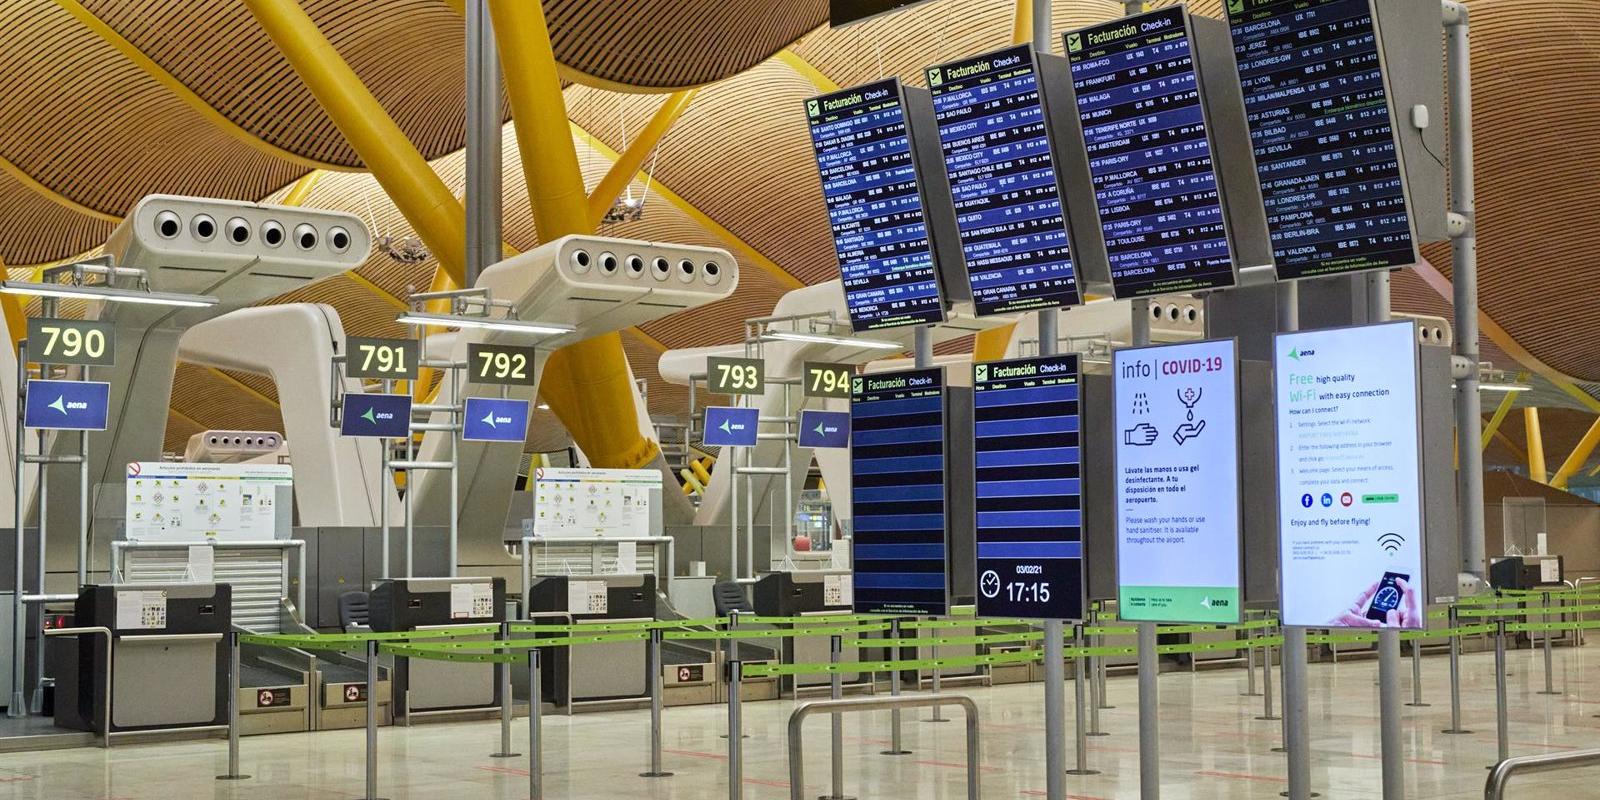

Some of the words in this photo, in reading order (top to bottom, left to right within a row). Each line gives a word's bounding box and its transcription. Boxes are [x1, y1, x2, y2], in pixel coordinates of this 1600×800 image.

[1087, 22, 1137, 45] Facturación
[1140, 16, 1171, 32] Check-in
[1244, 19, 1281, 33] BARCELONA
[1247, 40, 1267, 49] JEREZ
[1328, 23, 1337, 31] T4
[1250, 54, 1291, 68] LONDRES-GW
[946, 59, 990, 79] Facturación
[992, 54, 1020, 68] Check-in
[1085, 73, 1116, 86] FRANKFURT
[1254, 76, 1270, 84] LYON
[823, 92, 862, 111] Facturación
[864, 88, 888, 100] Check-in
[1088, 92, 1110, 102] MALAGA
[956, 107, 971, 115] PAULO
[1091, 108, 1112, 118] MUNICH
[1260, 107, 1289, 118] ASTURIAS
[1094, 123, 1118, 133] TENERIFE
[1118, 119, 1137, 129] NORTE
[1264, 126, 1286, 136] BILBAO
[952, 138, 971, 147] BUENOS
[1098, 138, 1130, 150] AMSTERDAM
[1267, 143, 1292, 153] SEVILLA
[1101, 154, 1129, 165] PARIS-ORY
[1270, 158, 1306, 170] SANTANDER
[829, 164, 853, 173] BARCELONA
[958, 167, 982, 177] SANTIAGO
[832, 178, 856, 187] BARCELONA
[971, 181, 987, 189] PAULO
[1274, 174, 1320, 187] GRANADA-JAEN
[1276, 192, 1316, 204] LONDRES-HR
[1110, 204, 1130, 213] LISBOA
[967, 213, 982, 221] QUITO
[1280, 211, 1313, 221] PAMPLONA
[840, 221, 860, 229] ALICANTE
[1113, 219, 1142, 229] PARIS-ORY
[1283, 227, 1319, 238] BERLIN-BRA
[843, 235, 864, 243] SANTIAGO
[1116, 235, 1145, 245] TOULOUSE
[973, 241, 1001, 251] GUATEMALA
[1286, 245, 1316, 255] VALENCIA
[1119, 250, 1152, 261] BARCELONA
[849, 263, 869, 271] ASTURIAS
[1122, 266, 1156, 276] BARCELONA
[852, 277, 869, 285] SEVILLA
[979, 272, 1002, 280] VALENCIA
[995, 285, 1016, 293] CANARIA
[41, 327, 105, 358] 790
[359, 345, 407, 373] 791
[478, 352, 527, 379] 792
[993, 363, 1036, 378] Facturación
[1040, 363, 1067, 374] Check-in
[1122, 360, 1150, 378] info
[1163, 357, 1222, 375] COVID-19
[717, 364, 758, 390] 793
[810, 369, 850, 393] 794
[1289, 373, 1313, 384] Free
[1316, 375, 1330, 384] high
[1332, 374, 1355, 383] quality
[868, 377, 906, 390] Facturación
[908, 377, 933, 387] Check-in
[1289, 389, 1316, 402] Wi-Fi
[1319, 392, 1333, 400] with
[1335, 392, 1350, 400] easy
[1352, 389, 1389, 398] connection
[66, 401, 88, 409] aena
[376, 411, 393, 419] aena
[495, 416, 512, 424] aena
[1190, 465, 1199, 473] gel
[1125, 476, 1165, 484] desinfectante.
[1291, 519, 1307, 527] Enjoy
[1320, 518, 1328, 526] fly
[1351, 518, 1370, 526] flying!
[1016, 565, 1042, 574] 03/02/21
[1006, 582, 1050, 602] 17:15
[1211, 598, 1228, 606] aena
